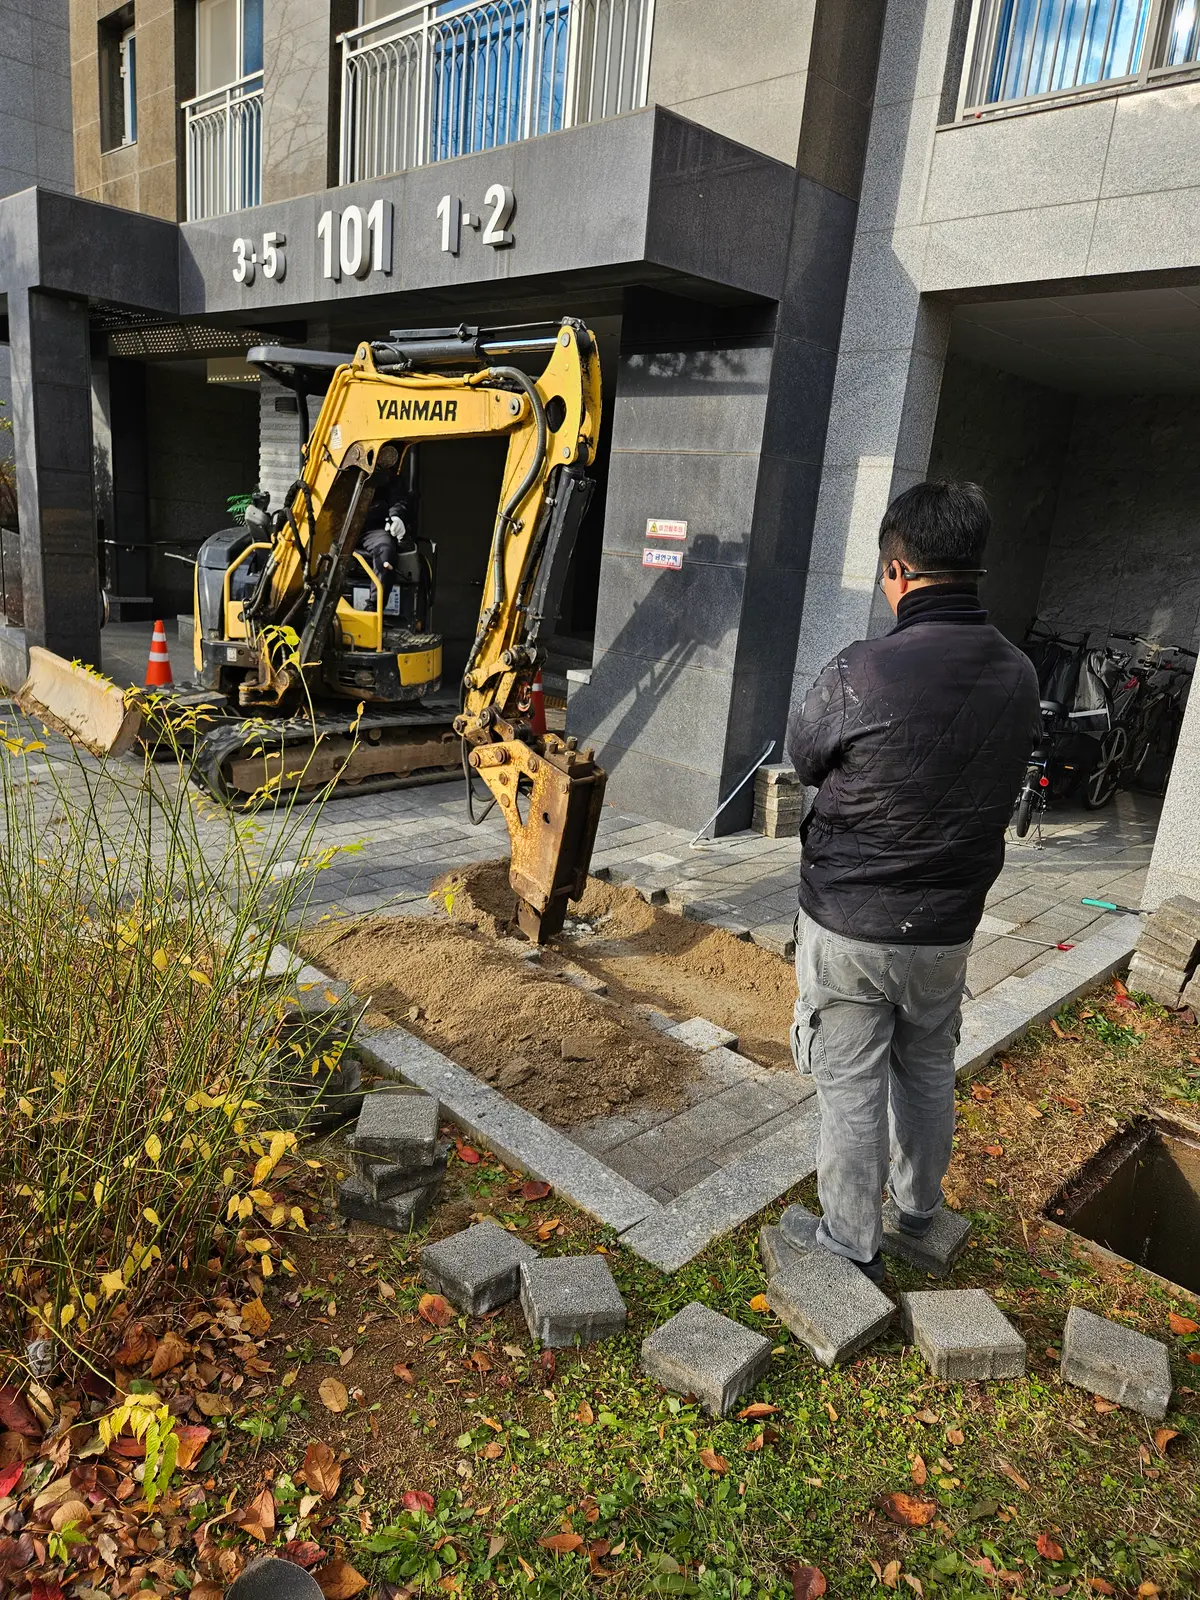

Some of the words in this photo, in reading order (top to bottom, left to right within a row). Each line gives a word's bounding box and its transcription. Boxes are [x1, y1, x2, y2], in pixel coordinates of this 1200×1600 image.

[232, 232, 286, 284] 3-5
[318, 199, 393, 280] 101
[436, 183, 514, 254] 1-2
[376, 399, 458, 421] YANMAR
[655, 554, 678, 562] 금연구역
